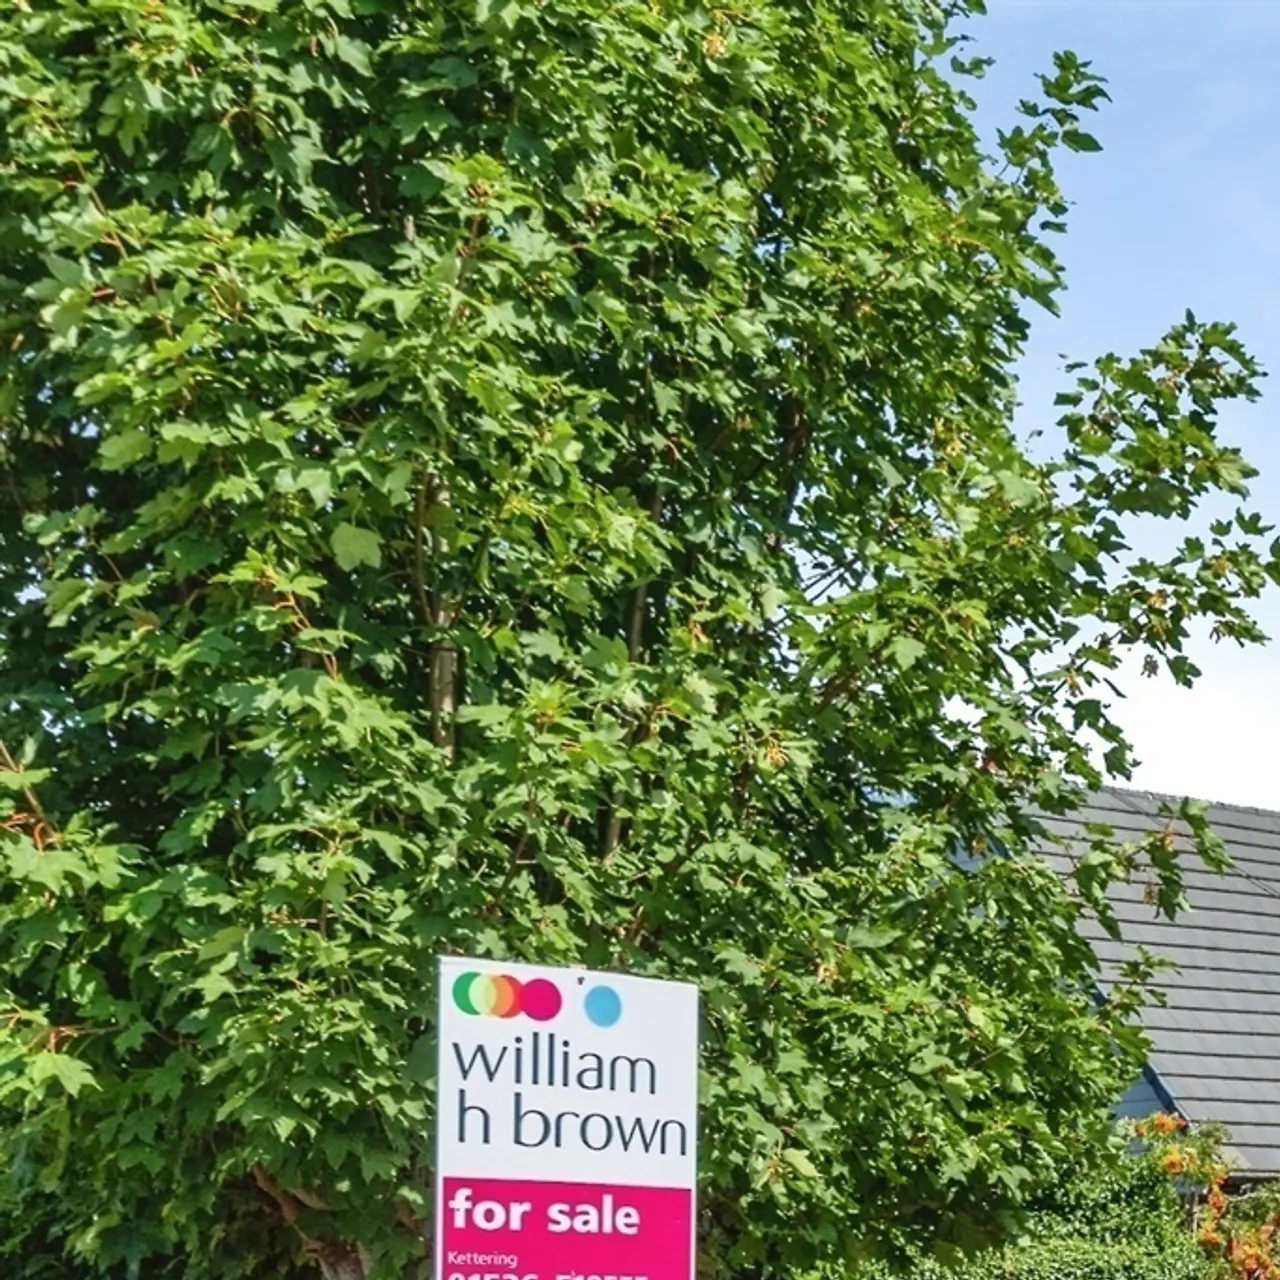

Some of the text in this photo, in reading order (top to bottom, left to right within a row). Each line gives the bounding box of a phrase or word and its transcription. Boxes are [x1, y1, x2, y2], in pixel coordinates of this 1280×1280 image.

[452, 1031, 657, 1094] william
[457, 1089, 687, 1156] h brown
[449, 1188, 640, 1234] for sale
[448, 1251, 517, 1269] Kettering
